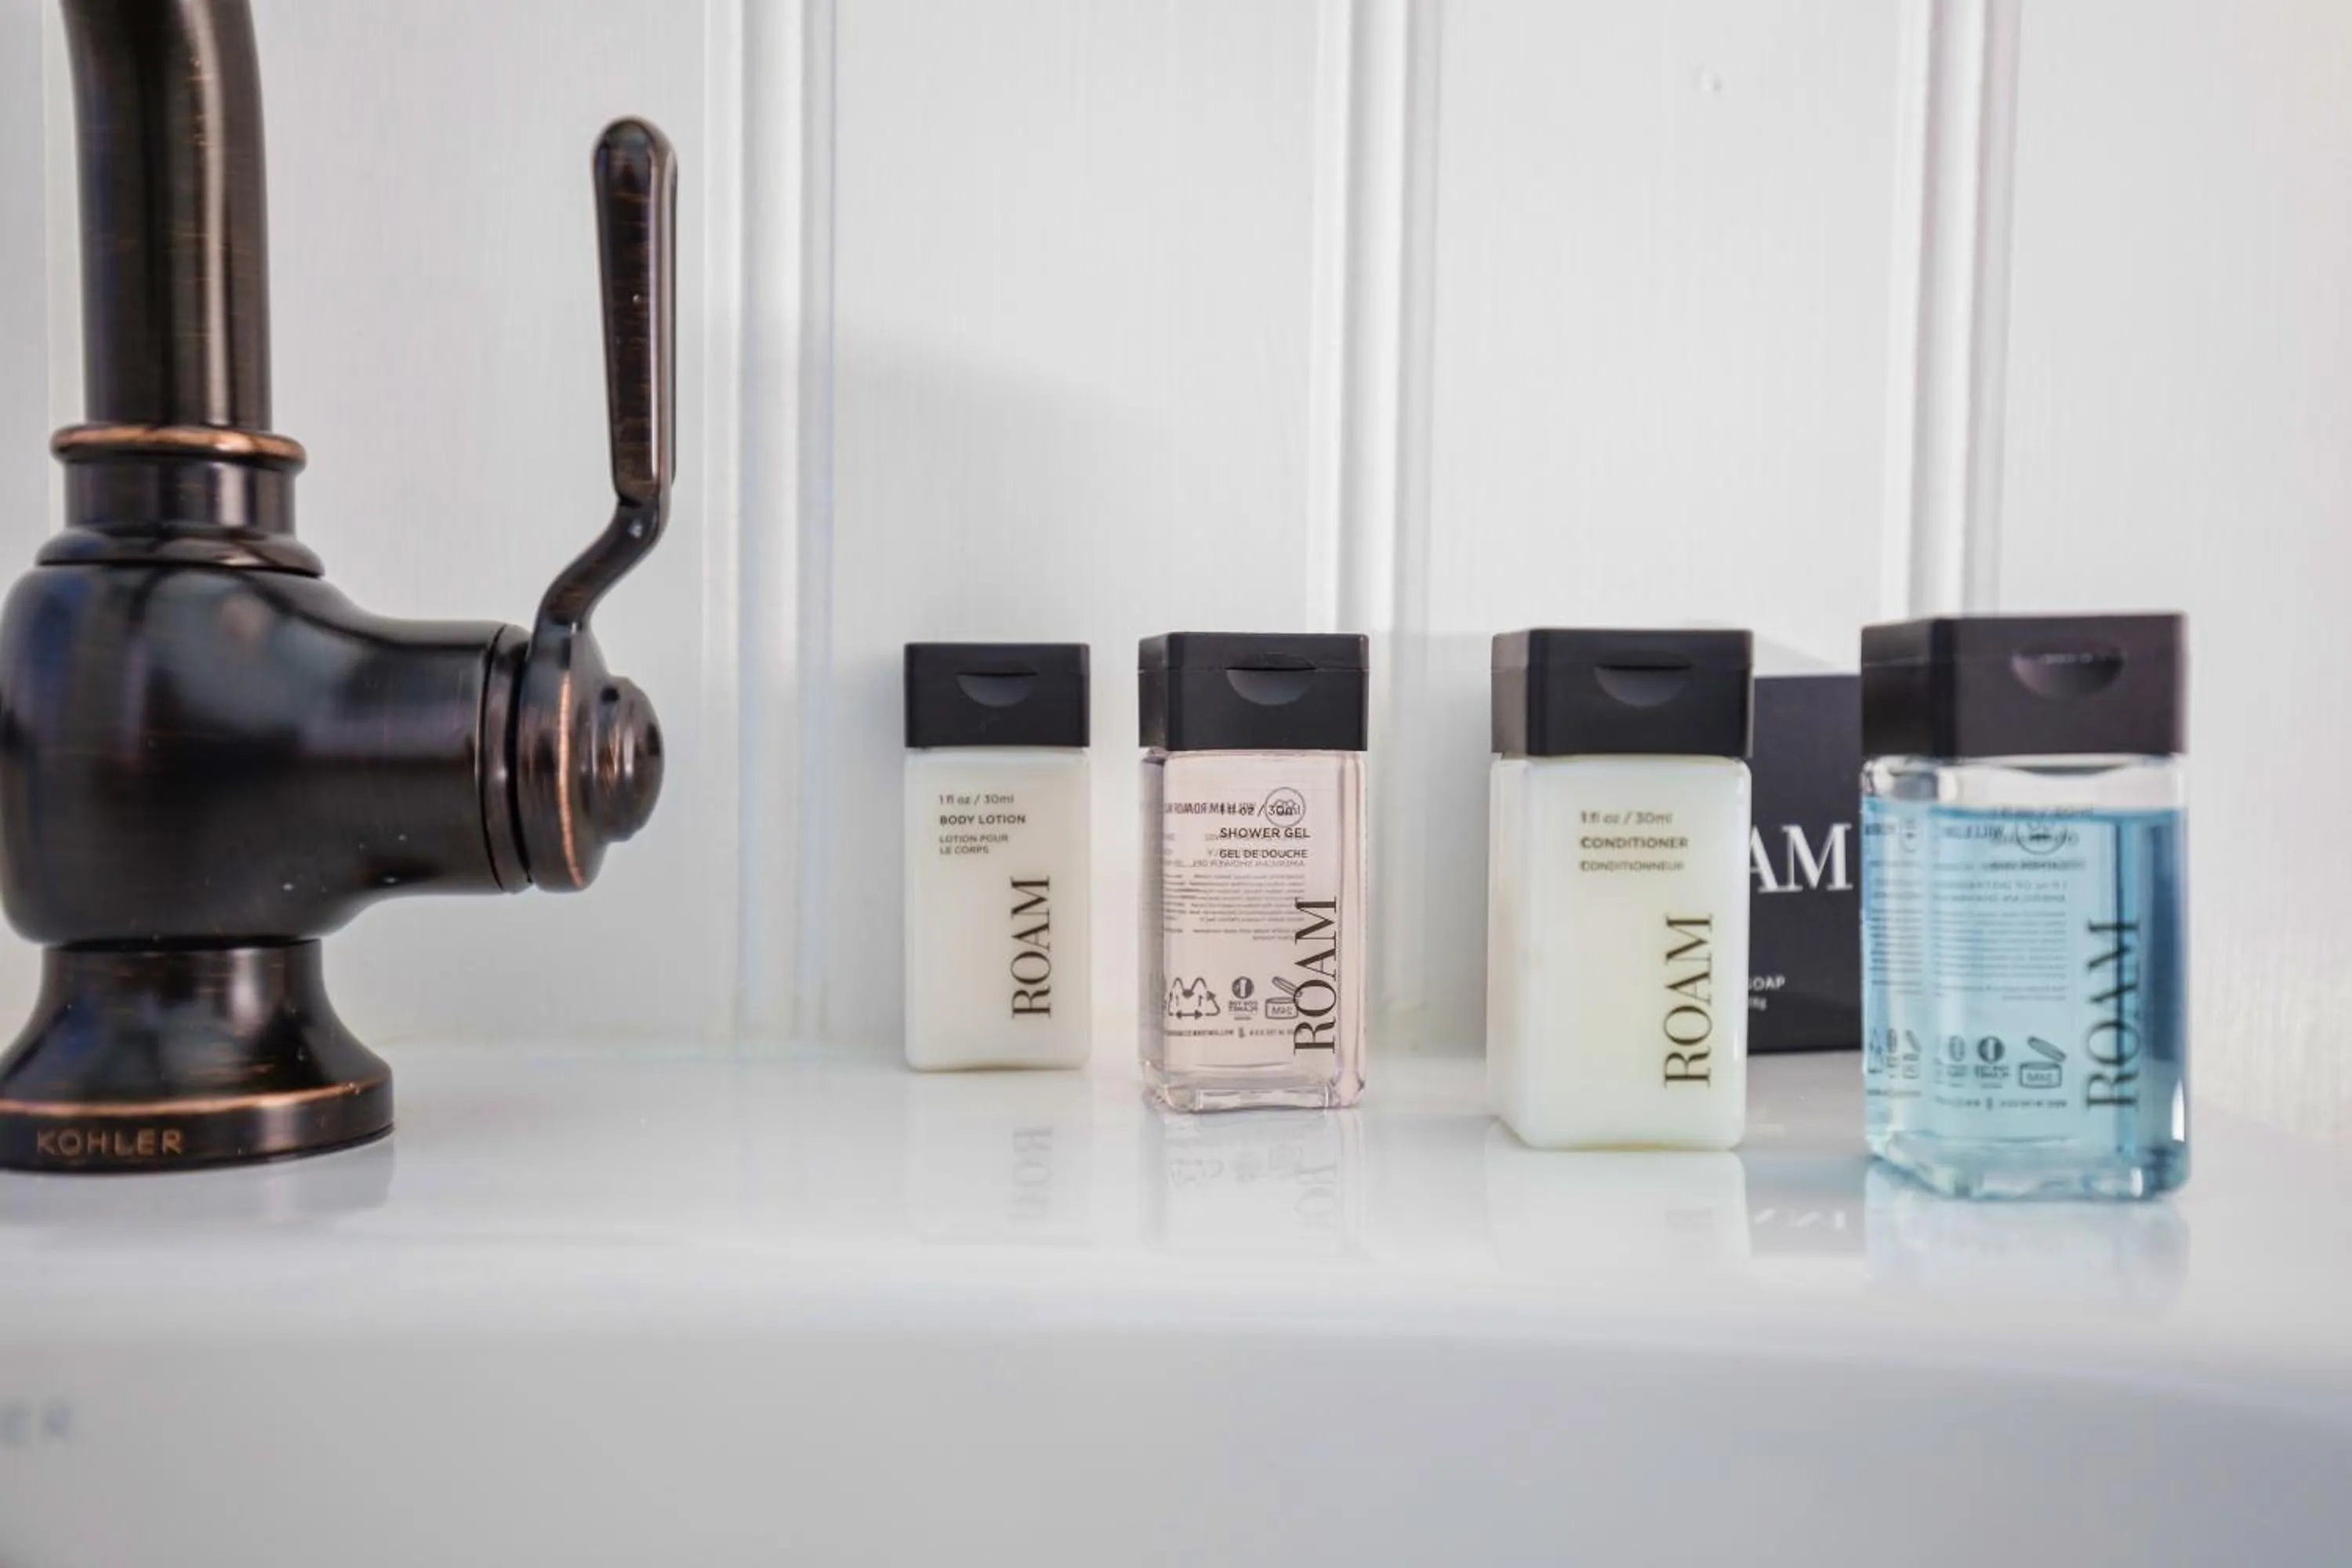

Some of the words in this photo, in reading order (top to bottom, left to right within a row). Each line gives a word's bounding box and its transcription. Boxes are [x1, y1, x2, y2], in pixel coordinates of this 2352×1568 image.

[946, 793, 954, 804] fl
[957, 795, 971, 804] oz
[984, 793, 1014, 804] 30ml
[939, 815, 975, 826] BODY
[978, 815, 1026, 826] LOTION
[1636, 811, 1673, 824] 30ml
[938, 834, 978, 843] LOTION
[980, 833, 1009, 843] POUR
[1219, 827, 1281, 839] SHOWER
[1284, 827, 1312, 839] GEL
[1580, 836, 1690, 849] CONDITIONER
[939, 846, 951, 855] LE
[954, 846, 989, 855] CORPS
[1219, 849, 1241, 859] GEL
[1243, 849, 1259, 859] DE
[1261, 849, 1309, 859] DOUCHE
[1580, 859, 1686, 872] CONDITIONNEUR
[1010, 876, 1052, 1019] ROAM
[1294, 896, 1337, 1054] ROAM
[1663, 913, 1712, 1088] ROAM
[2085, 919, 2141, 1112] ROAM
[36, 1129, 184, 1156] KOHLER
